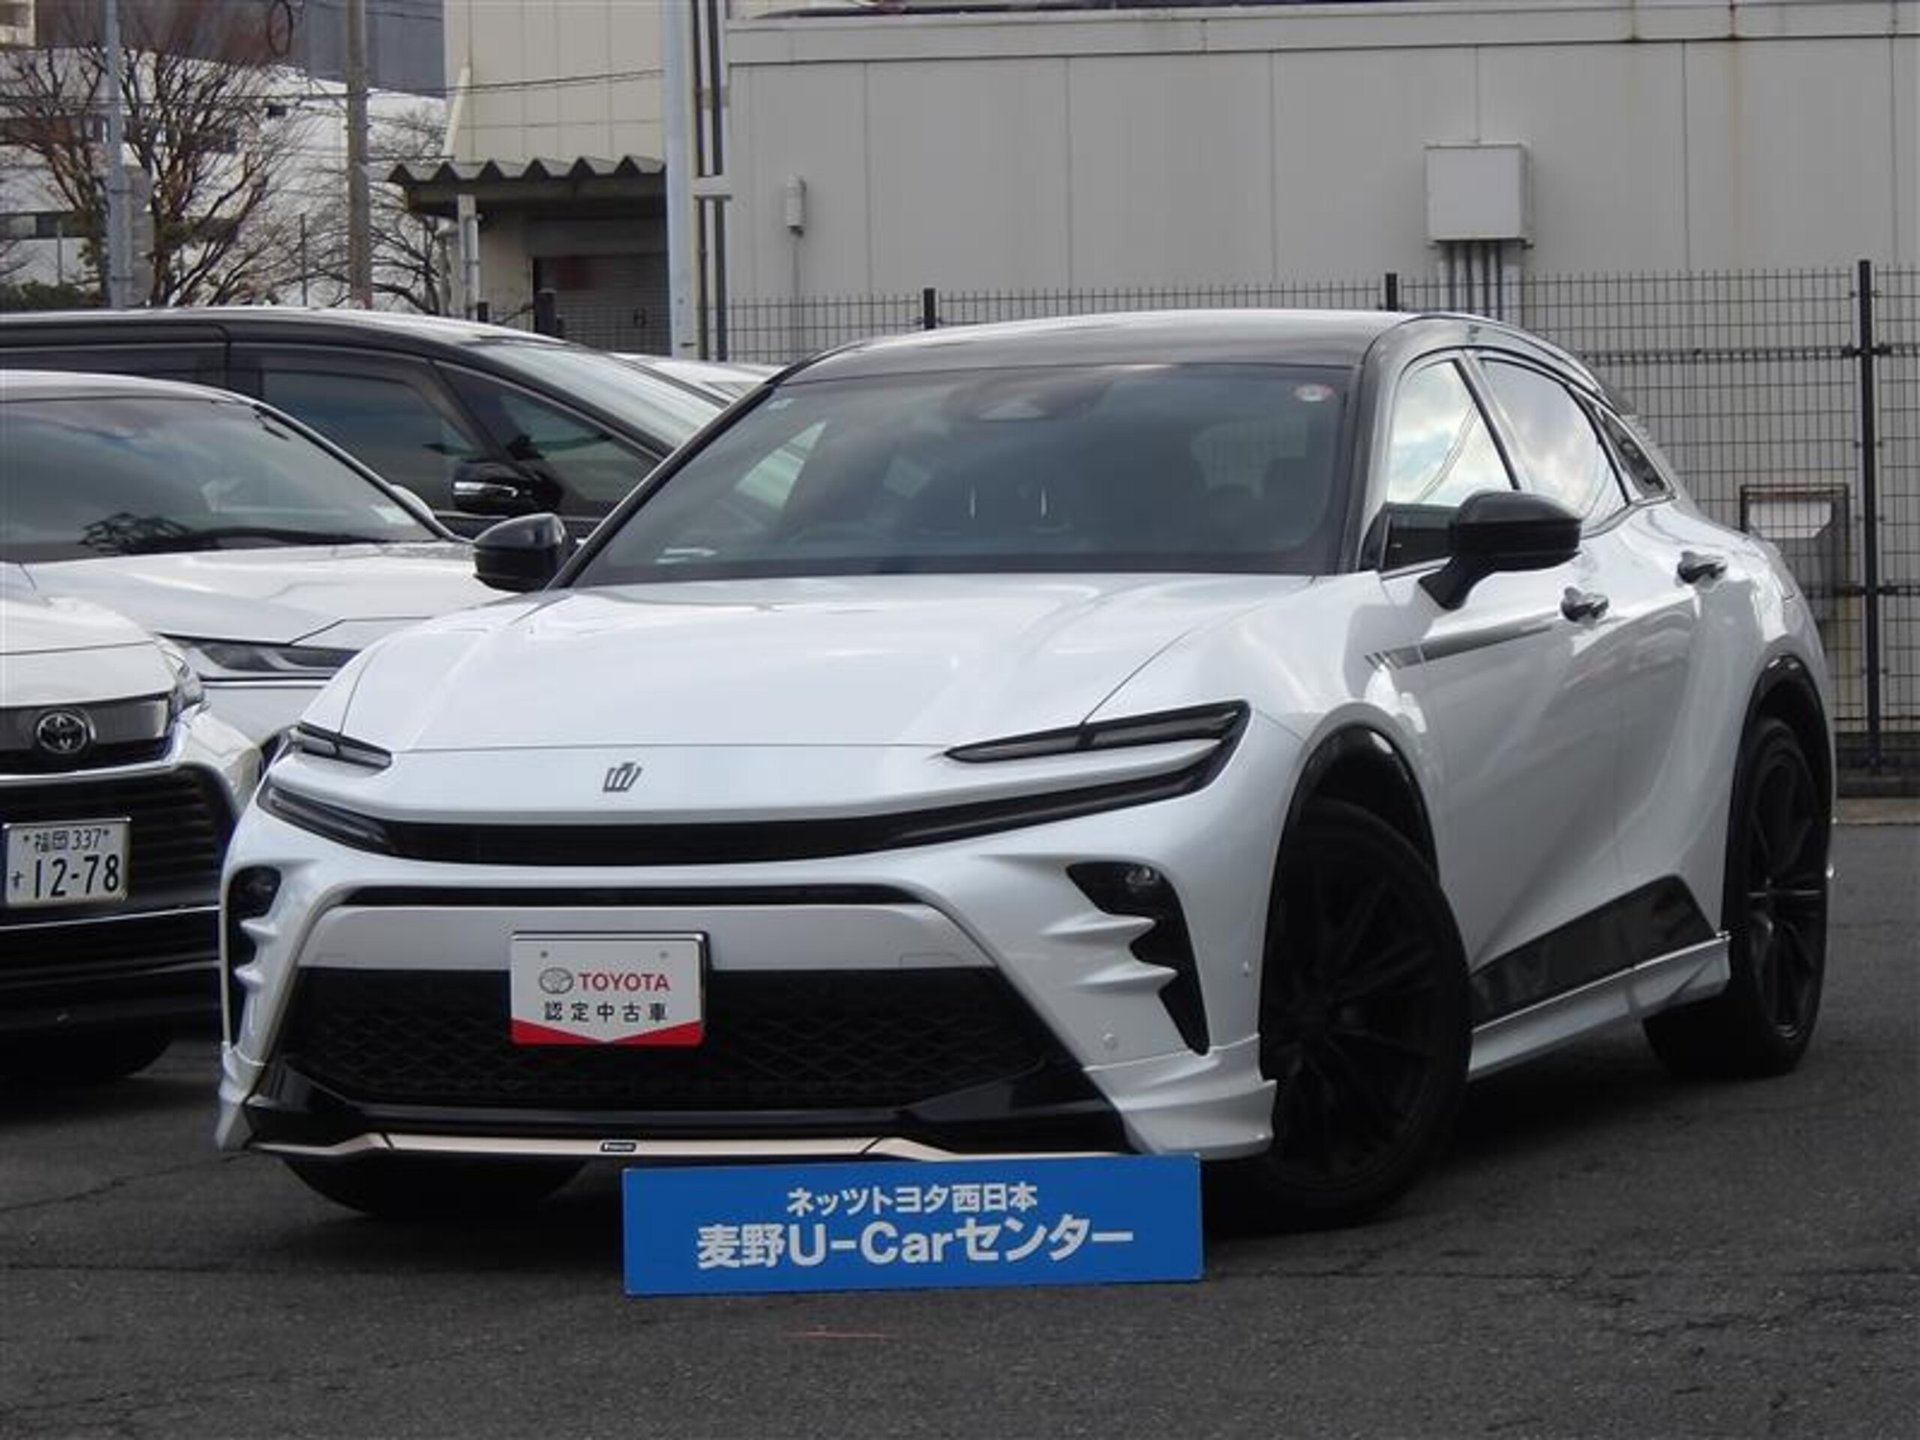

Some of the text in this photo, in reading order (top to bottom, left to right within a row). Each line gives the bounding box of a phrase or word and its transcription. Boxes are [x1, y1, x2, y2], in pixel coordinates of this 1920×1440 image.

[34, 854, 119, 898] 12-78
[578, 973, 671, 992] TOYOTA
[545, 1002, 668, 1023] 認定中古車
[787, 1182, 1038, 1217] ネッツトヨタ西日本
[697, 1214, 1134, 1269] 麦野U-Carセンター
